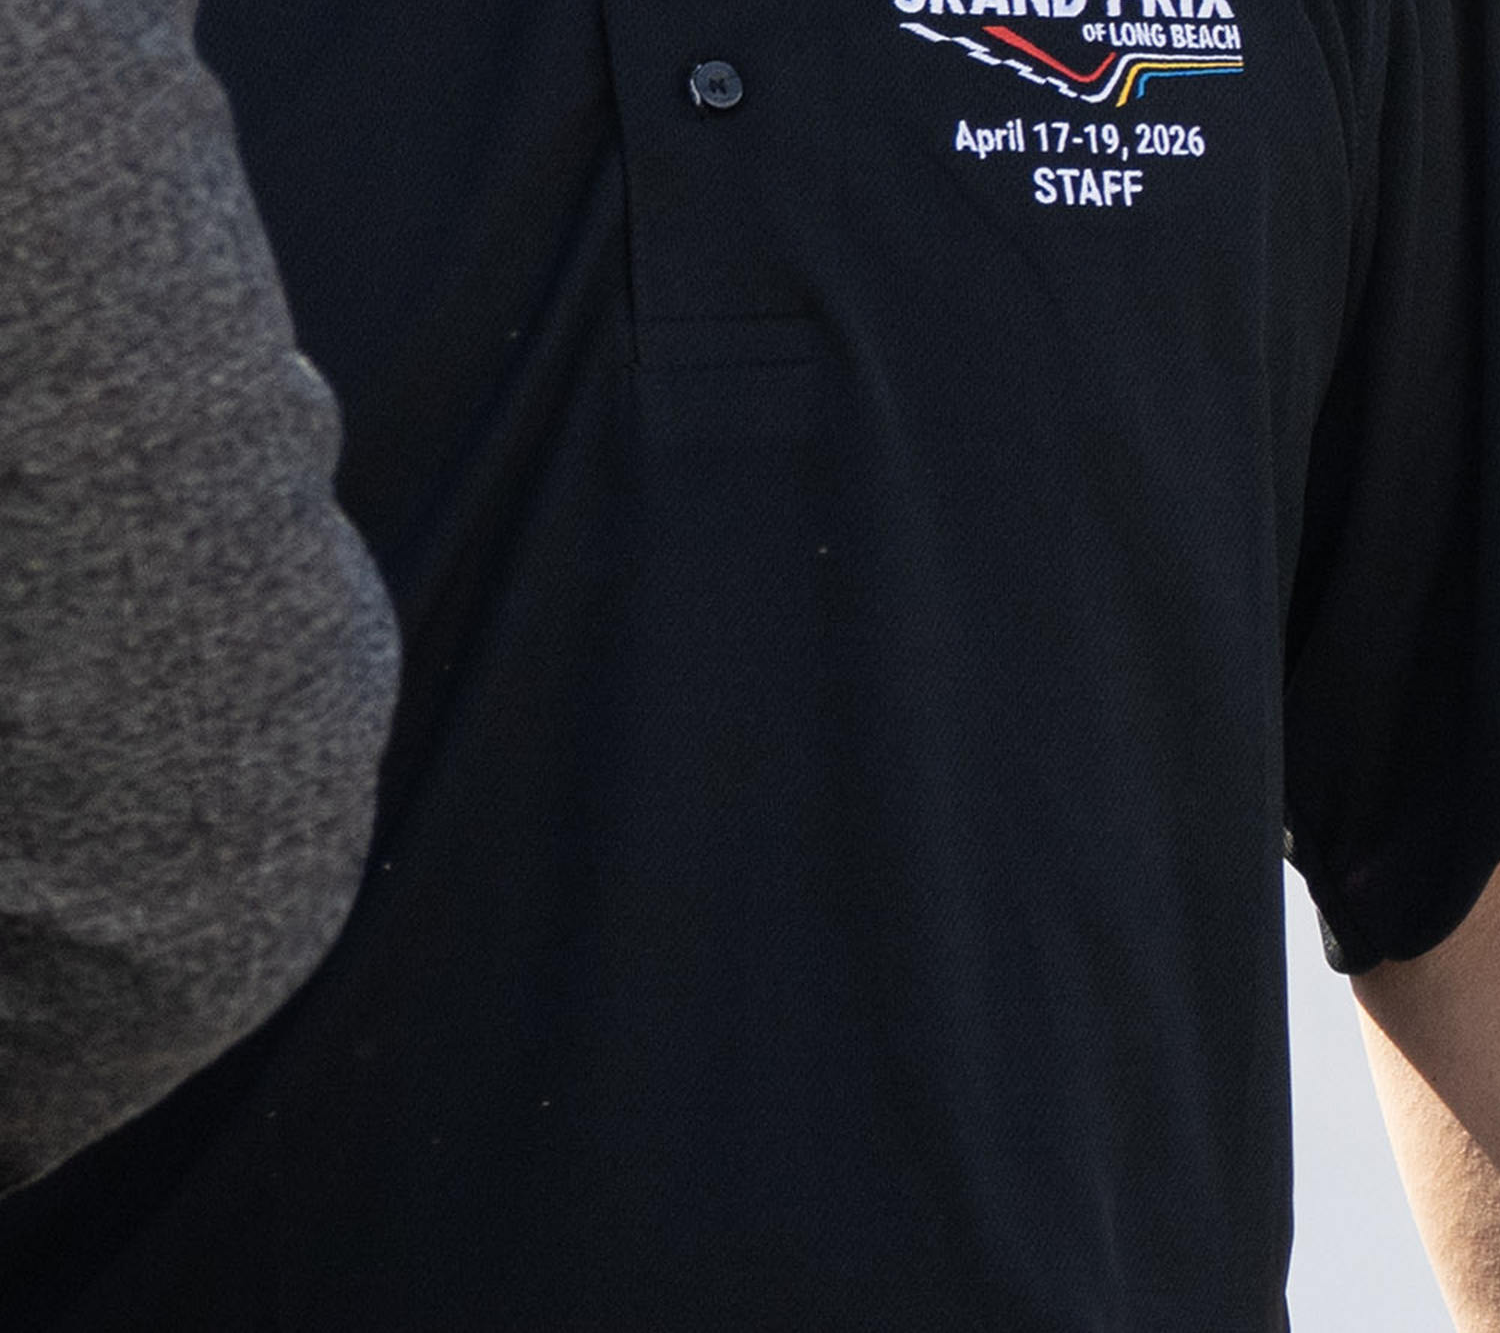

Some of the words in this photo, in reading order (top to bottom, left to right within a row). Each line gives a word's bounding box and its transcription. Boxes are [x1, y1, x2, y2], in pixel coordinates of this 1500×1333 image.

[1083, 23, 1105, 43] OF
[1110, 23, 1166, 47] LONG
[1171, 24, 1241, 50] BEACH
[954, 120, 1026, 158] April
[1033, 122, 1129, 161] 17-19,
[1135, 124, 1205, 157] 2026
[1032, 167, 1144, 207] STAFF
